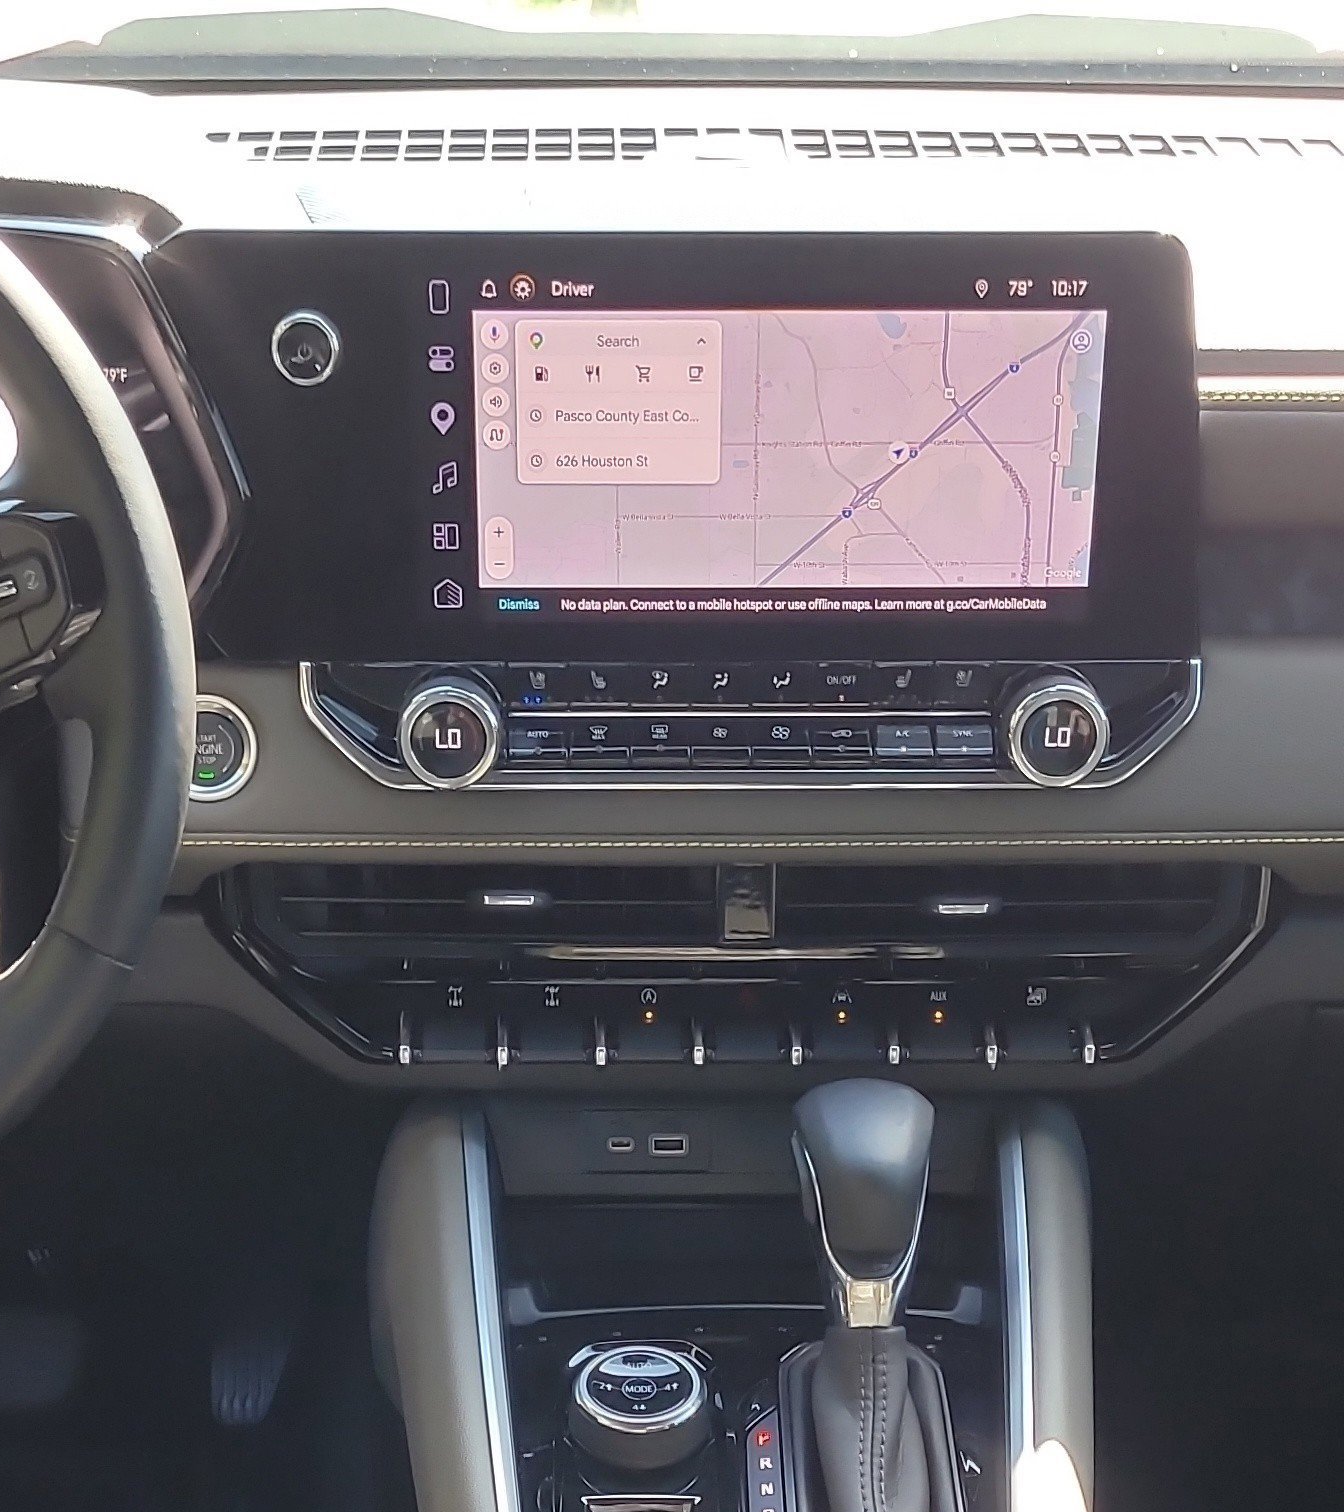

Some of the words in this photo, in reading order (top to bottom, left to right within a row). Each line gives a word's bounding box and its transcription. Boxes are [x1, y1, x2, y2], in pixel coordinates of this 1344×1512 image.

[551, 280, 595, 298] Driver
[1008, 279, 1033, 297] 79°
[1051, 279, 1089, 297] 10:17
[597, 334, 640, 348] Search
[555, 409, 593, 422] Pasco
[595, 409, 639, 425] County
[642, 409, 669, 422] East
[672, 409, 699, 422] Co...
[556, 454, 579, 468] 626
[581, 454, 634, 468] Houston
[636, 454, 649, 468] St
[1044, 567, 1082, 581] Google
[498, 599, 540, 611] Dismiss
[561, 599, 576, 611] No
[578, 599, 601, 611] data
[603, 599, 628, 613] plan.
[630, 599, 673, 611] Connect
[676, 599, 687, 611] to
[689, 602, 696, 611] a
[697, 598, 732, 611] mobile
[734, 599, 773, 613] hotspot
[775, 602, 786, 611] or
[788, 602, 806, 611] use
[808, 598, 840, 611] offline
[842, 601, 873, 613] maps.
[875, 599, 904, 611] Learn
[906, 601, 931, 611] more
[934, 600, 945, 611] at
[946, 598, 1048, 614] g.co/CarMobileData
[526, 730, 549, 739] AUTO
[196, 743, 224, 755] NGINE
[930, 990, 947, 1001] AUX
[625, 1384, 654, 1394] MODE
[757, 1431, 771, 1447] P
[759, 1457, 773, 1470] R
[760, 1482, 774, 1496] N
